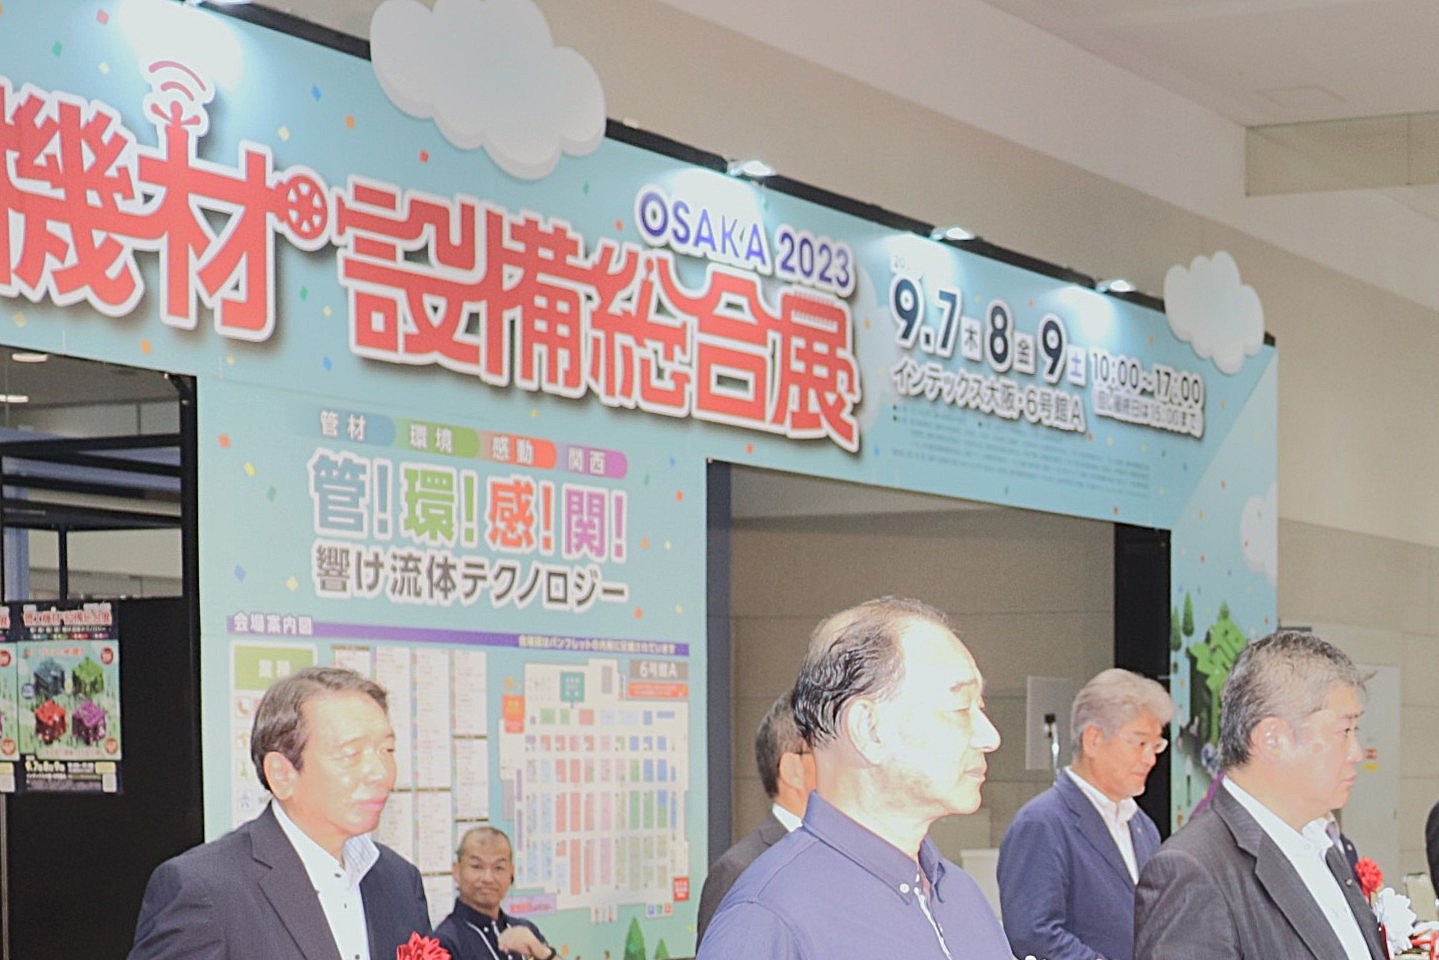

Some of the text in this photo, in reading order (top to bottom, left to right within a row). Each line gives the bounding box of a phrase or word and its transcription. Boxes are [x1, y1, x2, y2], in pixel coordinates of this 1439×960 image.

[640, 190, 851, 289] OSAKA 2023
[319, 410, 607, 476] 管材 環境 感動 関西
[315, 544, 626, 606] 響け流体テクノロジー
